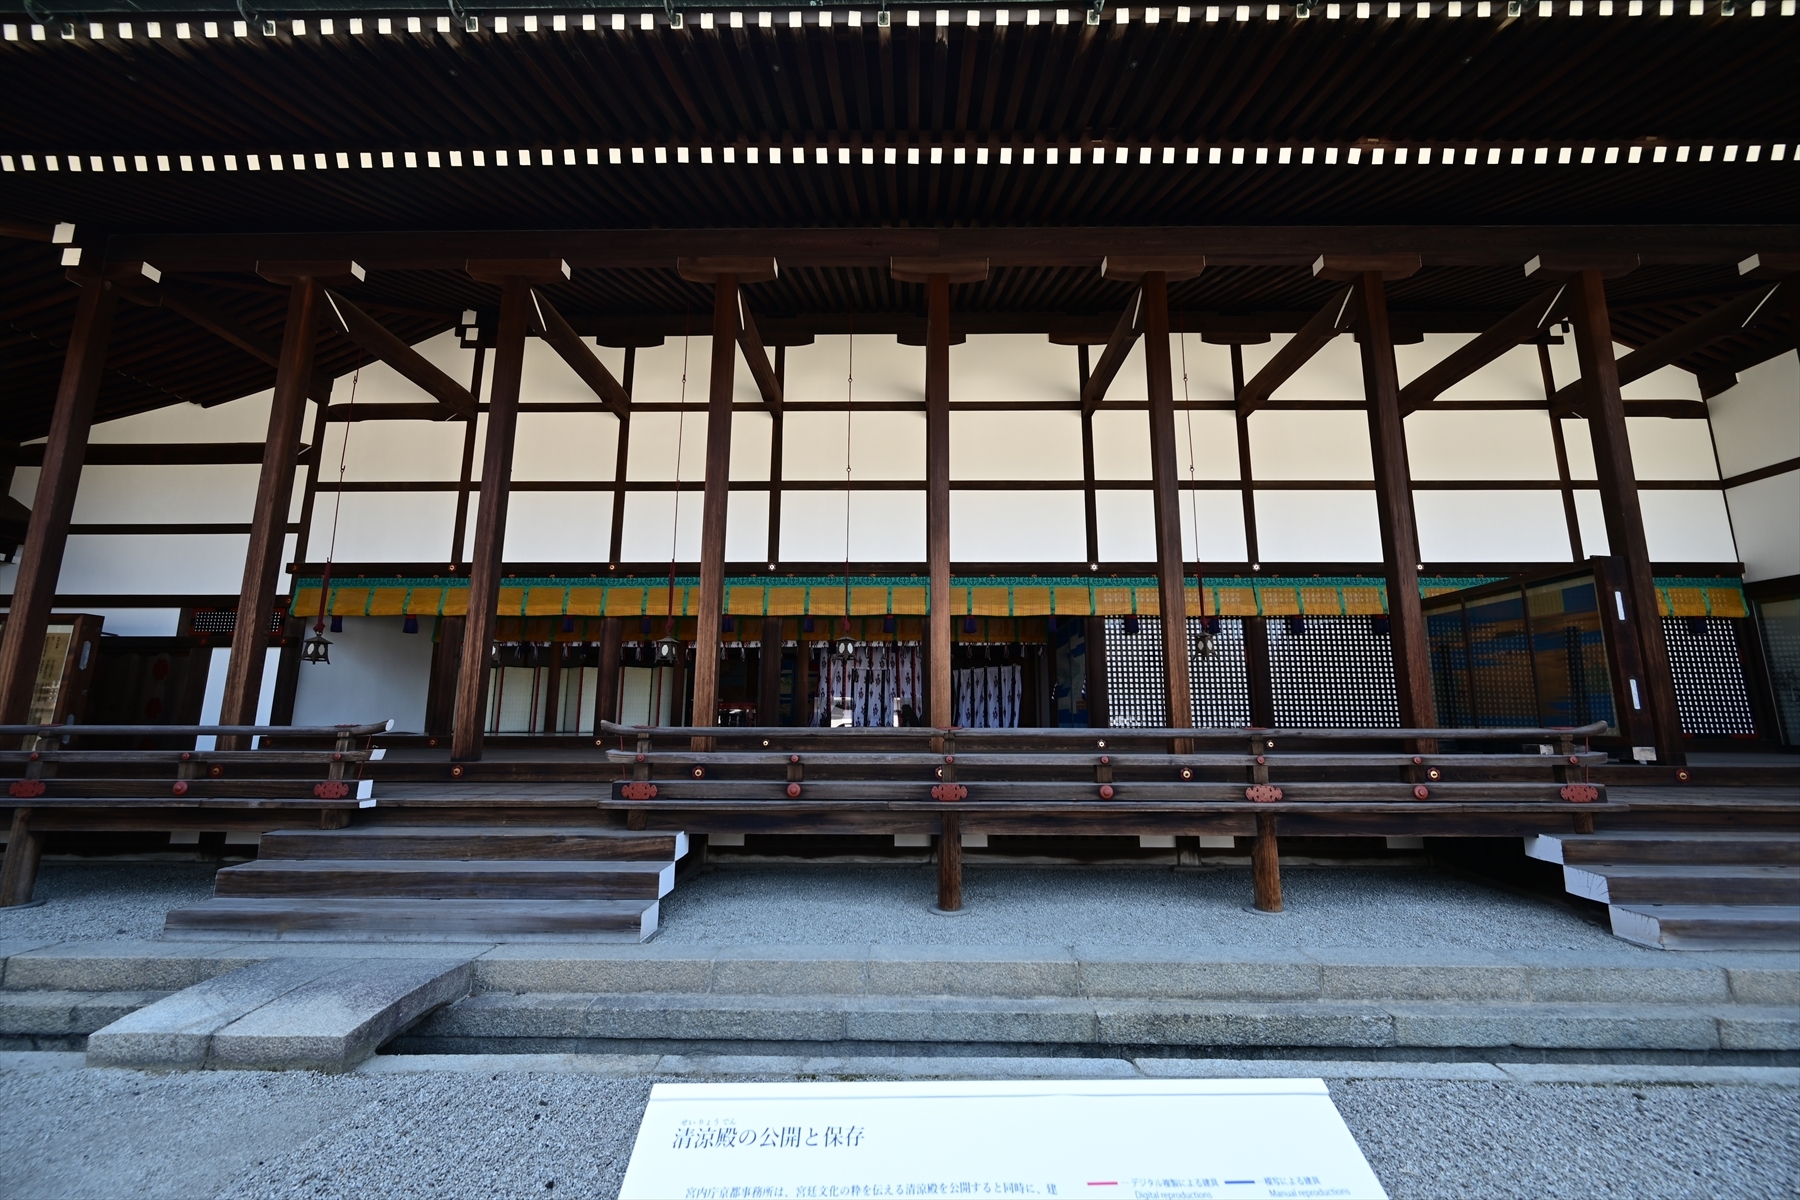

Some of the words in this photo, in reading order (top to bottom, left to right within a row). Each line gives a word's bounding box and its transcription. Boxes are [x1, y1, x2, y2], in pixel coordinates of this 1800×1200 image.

[672, 1126, 865, 1149] 清涼殿の公開と保存
[1135, 1190, 1160, 1199] Digital
[1161, 1191, 1213, 1199] reproductions
[1268, 1189, 1297, 1197] Manual
[1298, 1188, 1351, 1198] reproductions
